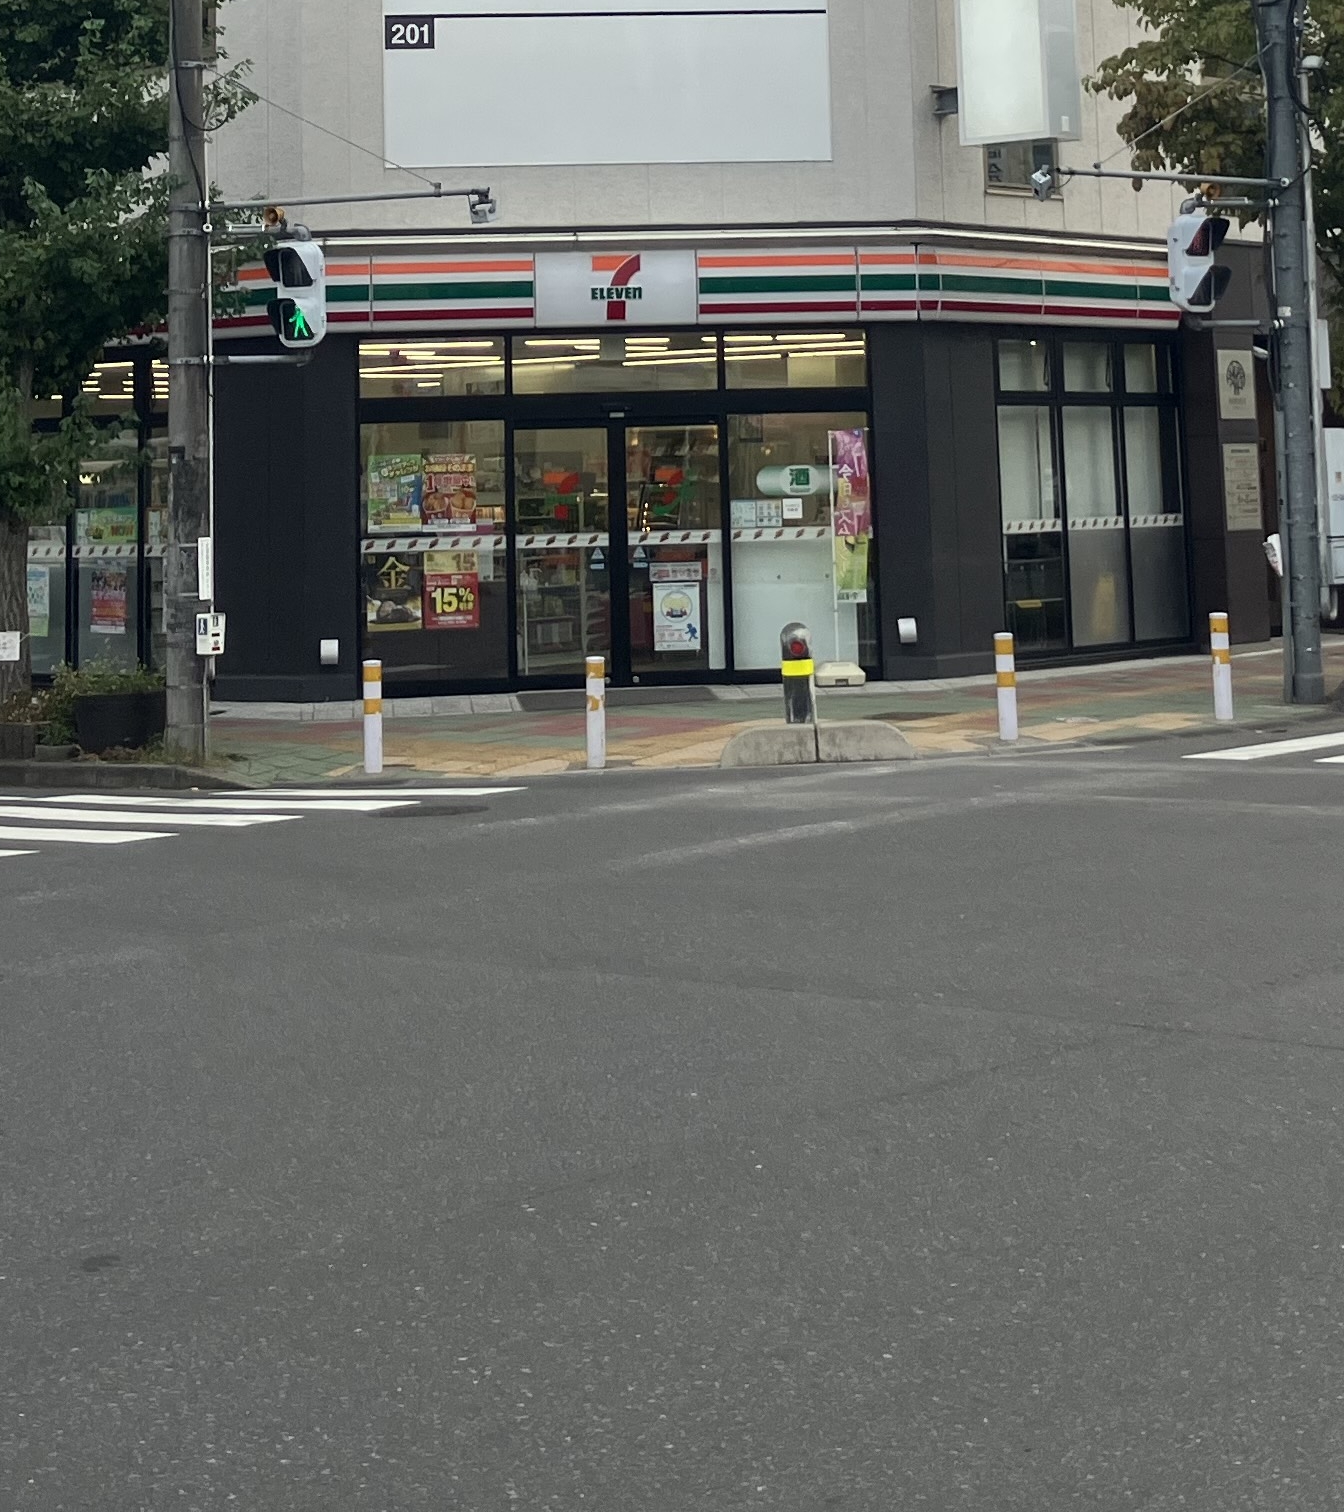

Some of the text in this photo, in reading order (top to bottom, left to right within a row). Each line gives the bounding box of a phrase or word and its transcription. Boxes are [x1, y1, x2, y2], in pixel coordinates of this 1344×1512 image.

[390, 24, 430, 45] 201
[789, 467, 810, 486] 酒
[377, 556, 411, 591] 金
